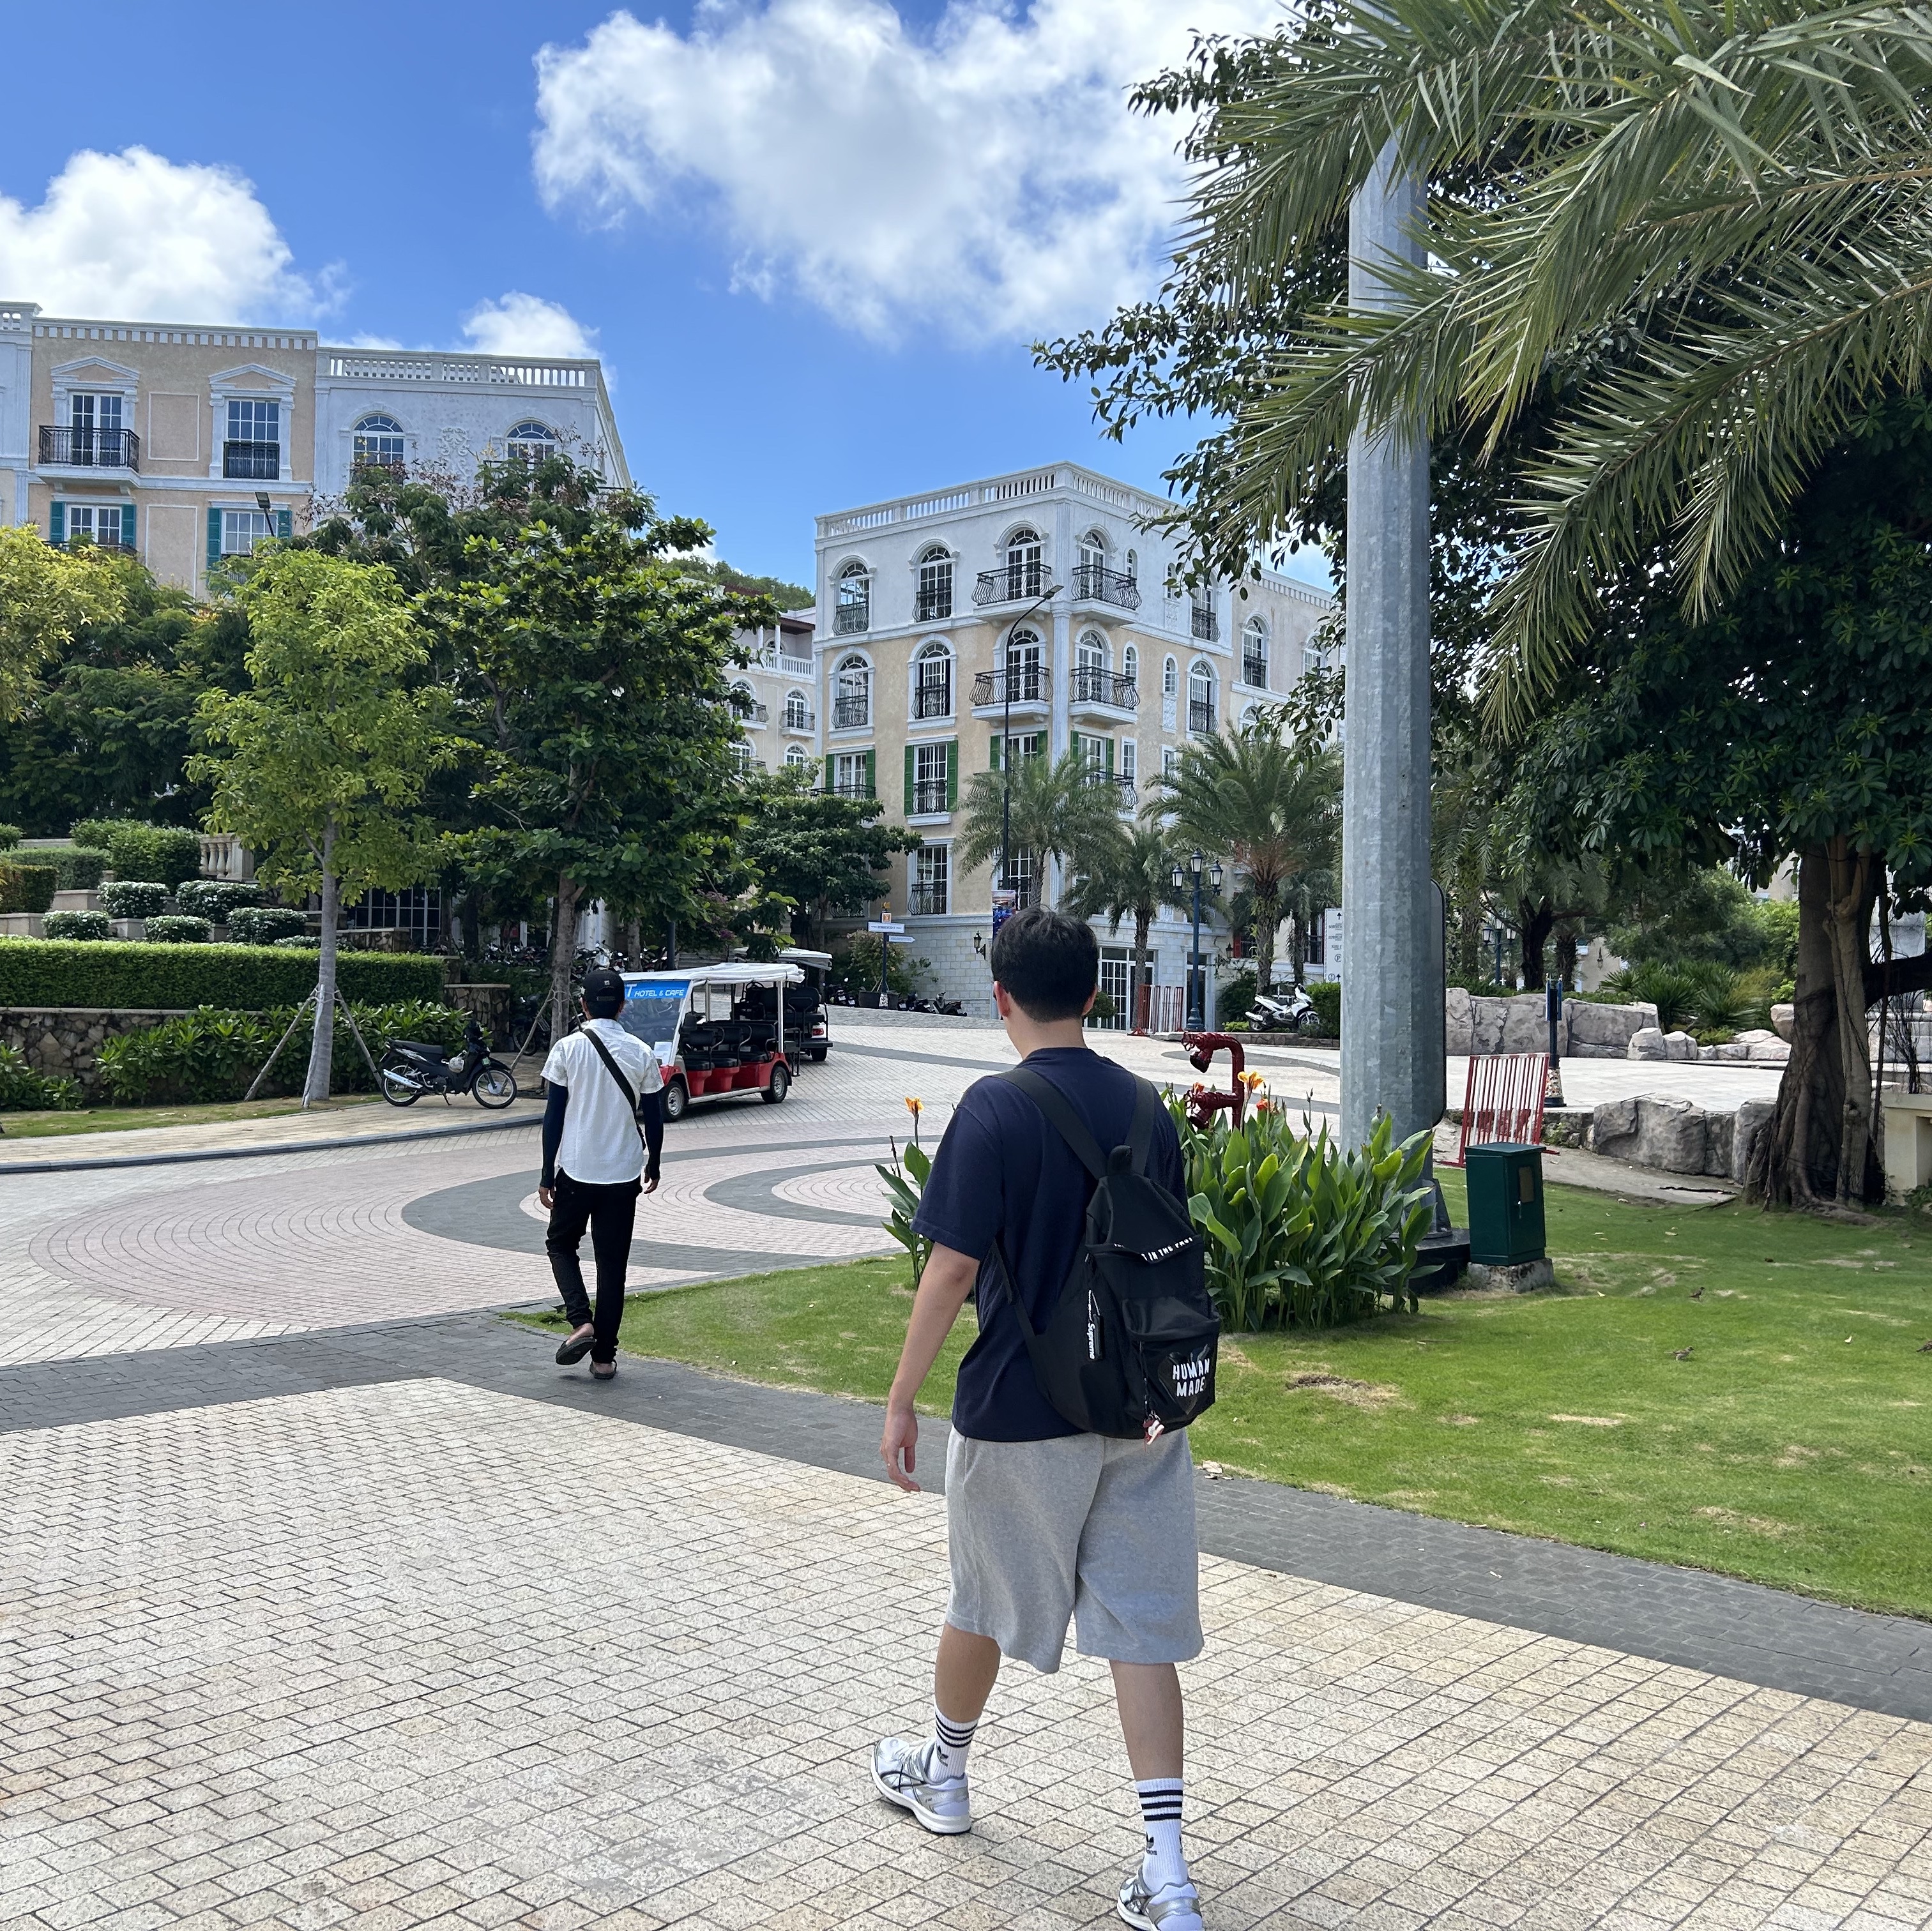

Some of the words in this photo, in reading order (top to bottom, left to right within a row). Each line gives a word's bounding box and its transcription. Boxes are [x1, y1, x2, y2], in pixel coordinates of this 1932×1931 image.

[1086, 1322, 1095, 1359] Supreme
[1172, 1358, 1210, 1381] HUMAN
[1176, 1376, 1206, 1397] MADE
